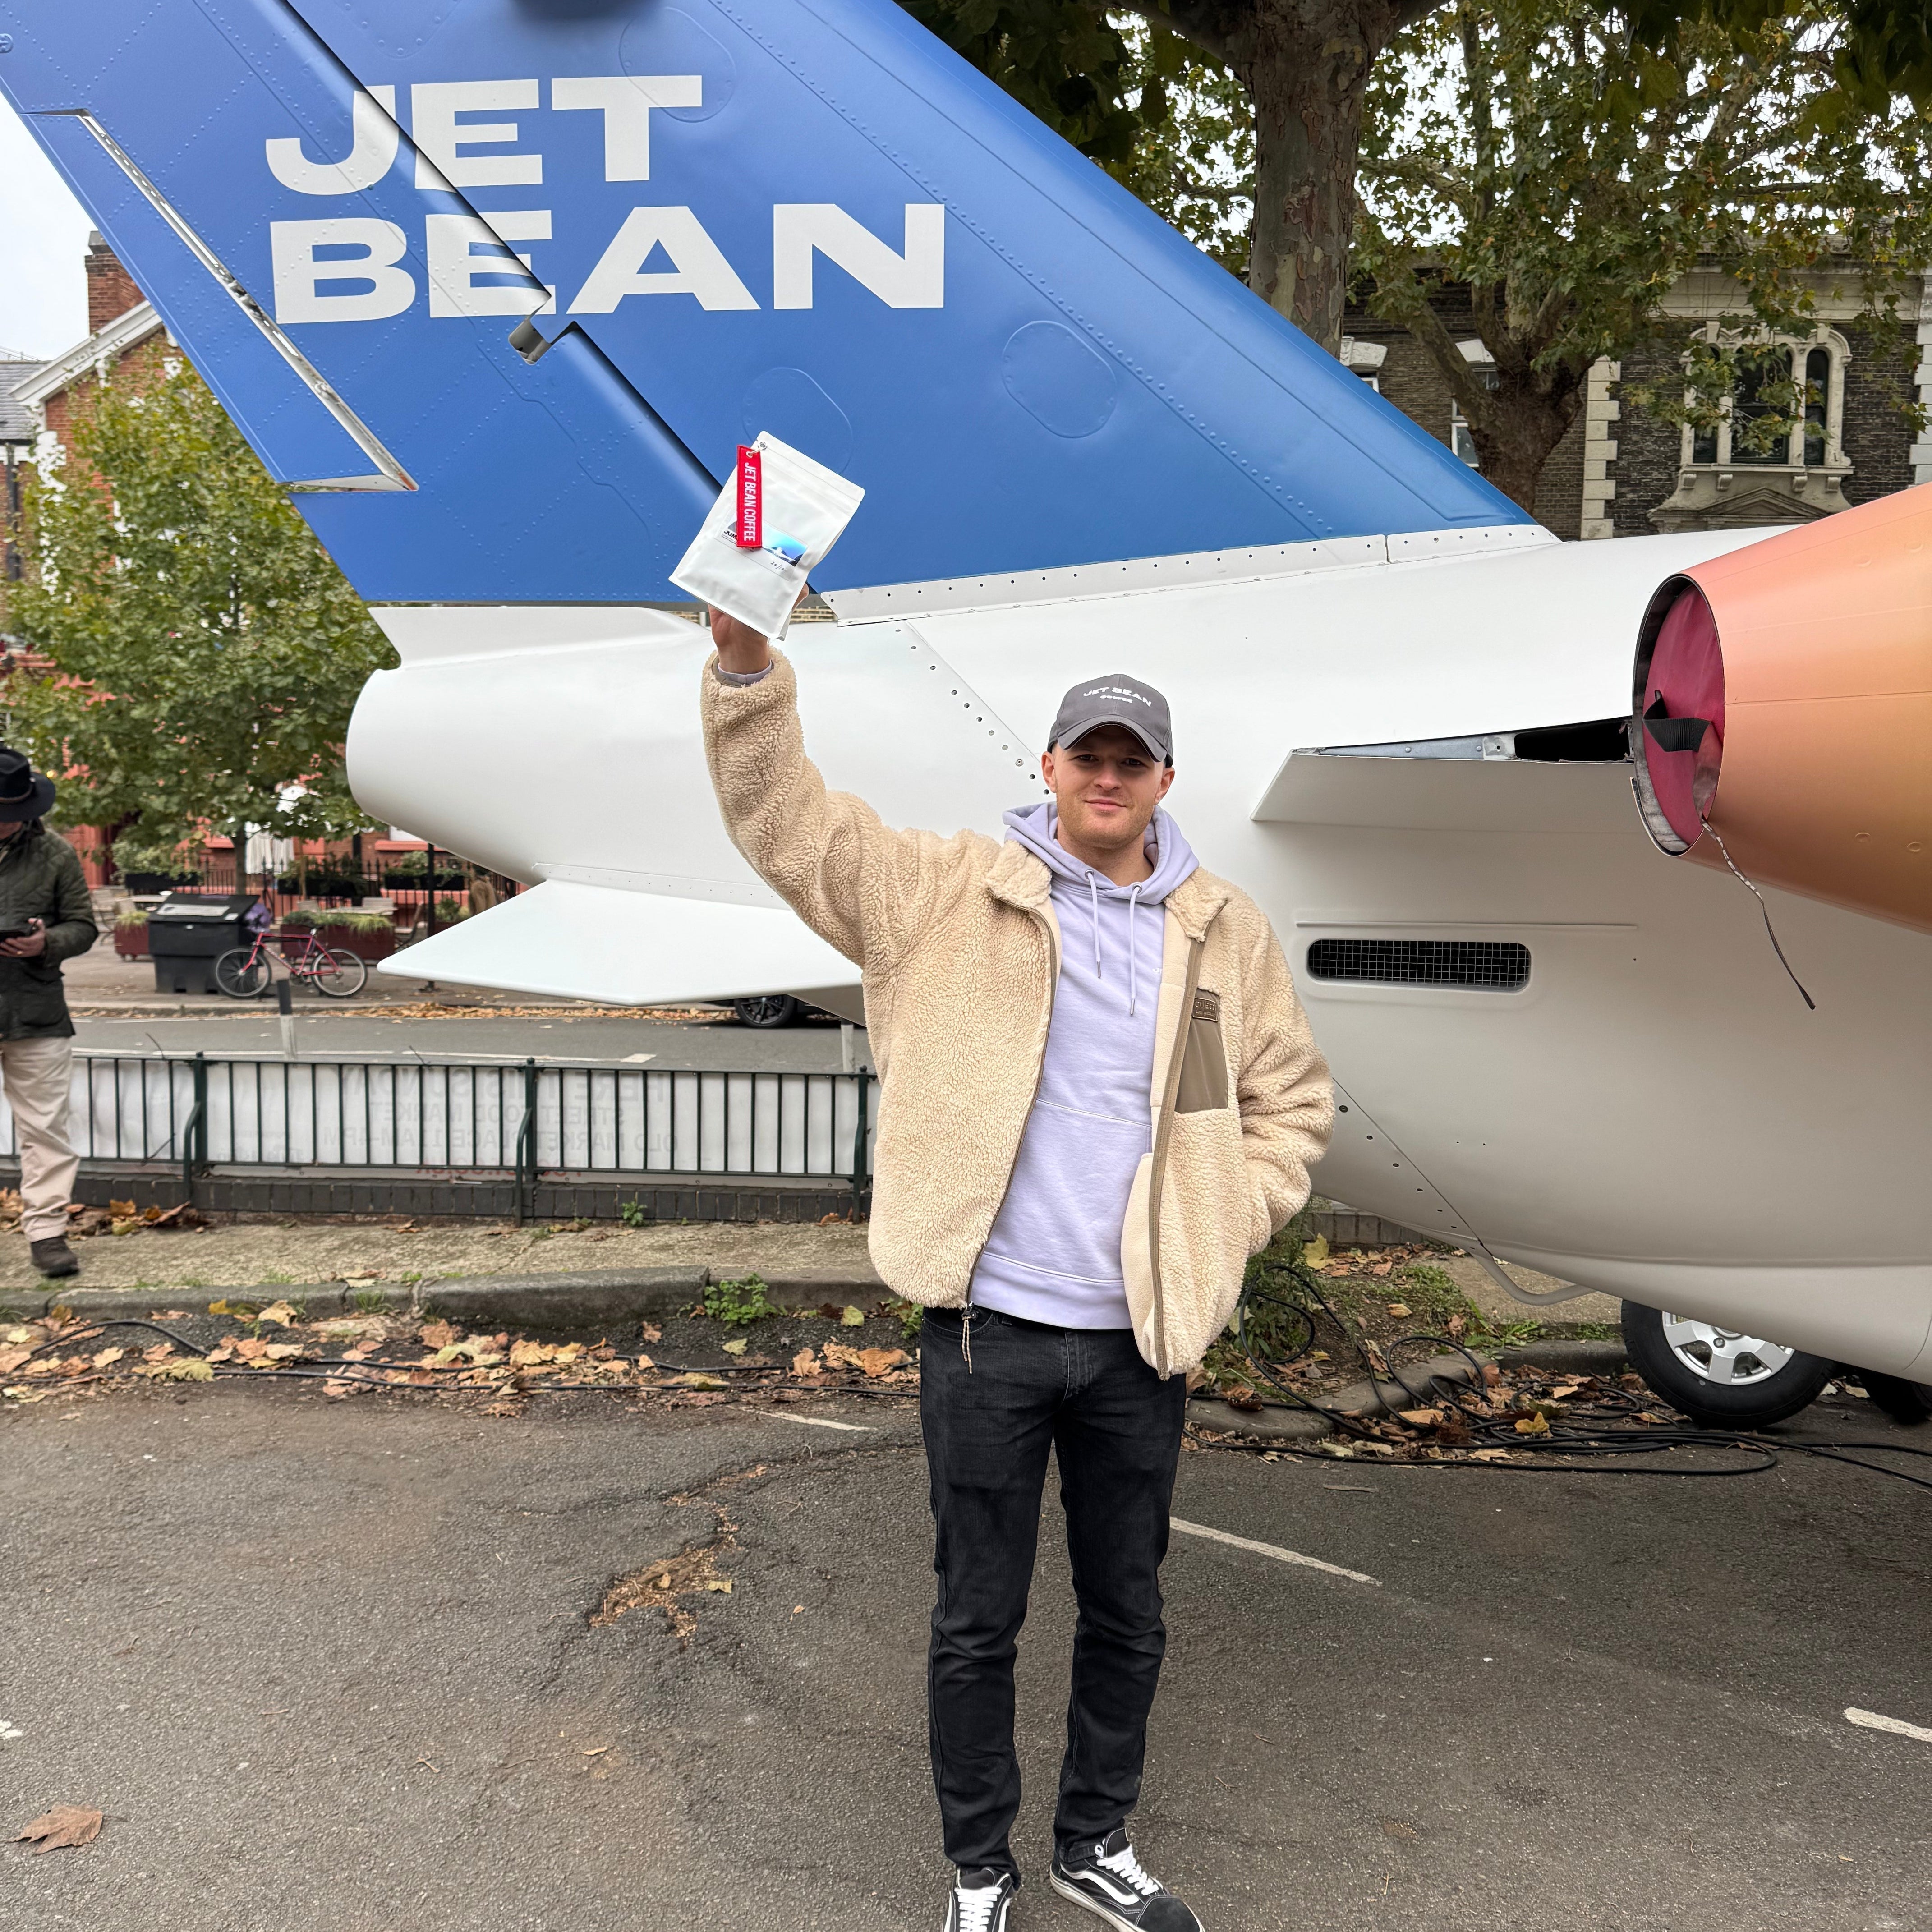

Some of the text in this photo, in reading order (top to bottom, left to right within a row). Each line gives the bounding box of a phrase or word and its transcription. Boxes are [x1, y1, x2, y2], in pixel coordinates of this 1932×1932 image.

[266, 75, 702, 195] JET
[270, 203, 945, 324] BEAN
[744, 462, 757, 542] JET BEAN COFFEE
[1083, 687, 1151, 707] JET BEAN
